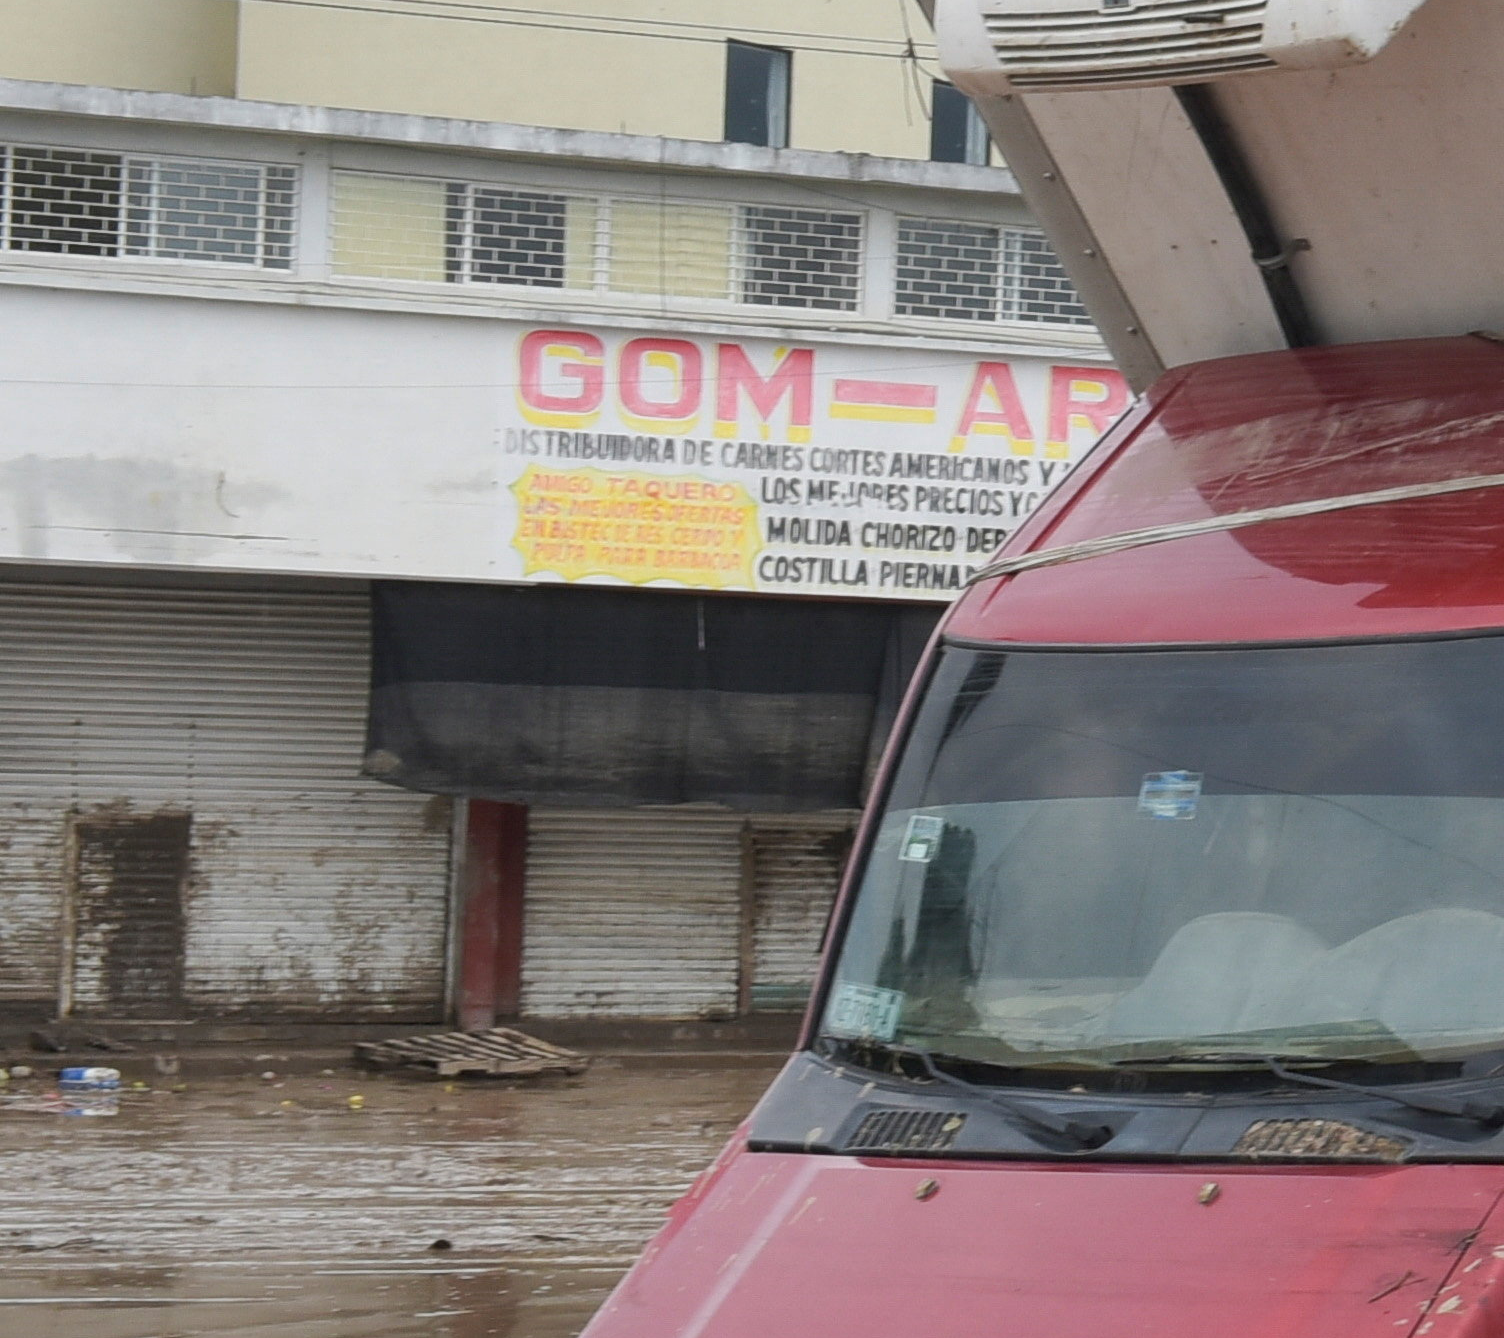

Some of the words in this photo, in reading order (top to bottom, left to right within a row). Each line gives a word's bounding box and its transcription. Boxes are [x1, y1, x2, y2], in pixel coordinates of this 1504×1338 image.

[684, 438, 713, 466] DE
[809, 447, 887, 477] CORTES
[888, 452, 1029, 485] AMERICANOS
[1039, 460, 1056, 487] Y
[529, 474, 593, 494] AMIGO
[606, 477, 735, 502] TAQUERO
[760, 476, 801, 505] LOS
[915, 486, 1004, 517] PRECIOS
[1007, 491, 1023, 517] Y
[767, 516, 851, 546] MOLIDA
[861, 521, 956, 552] CHORIZO
[759, 555, 868, 586] COSTILLA
